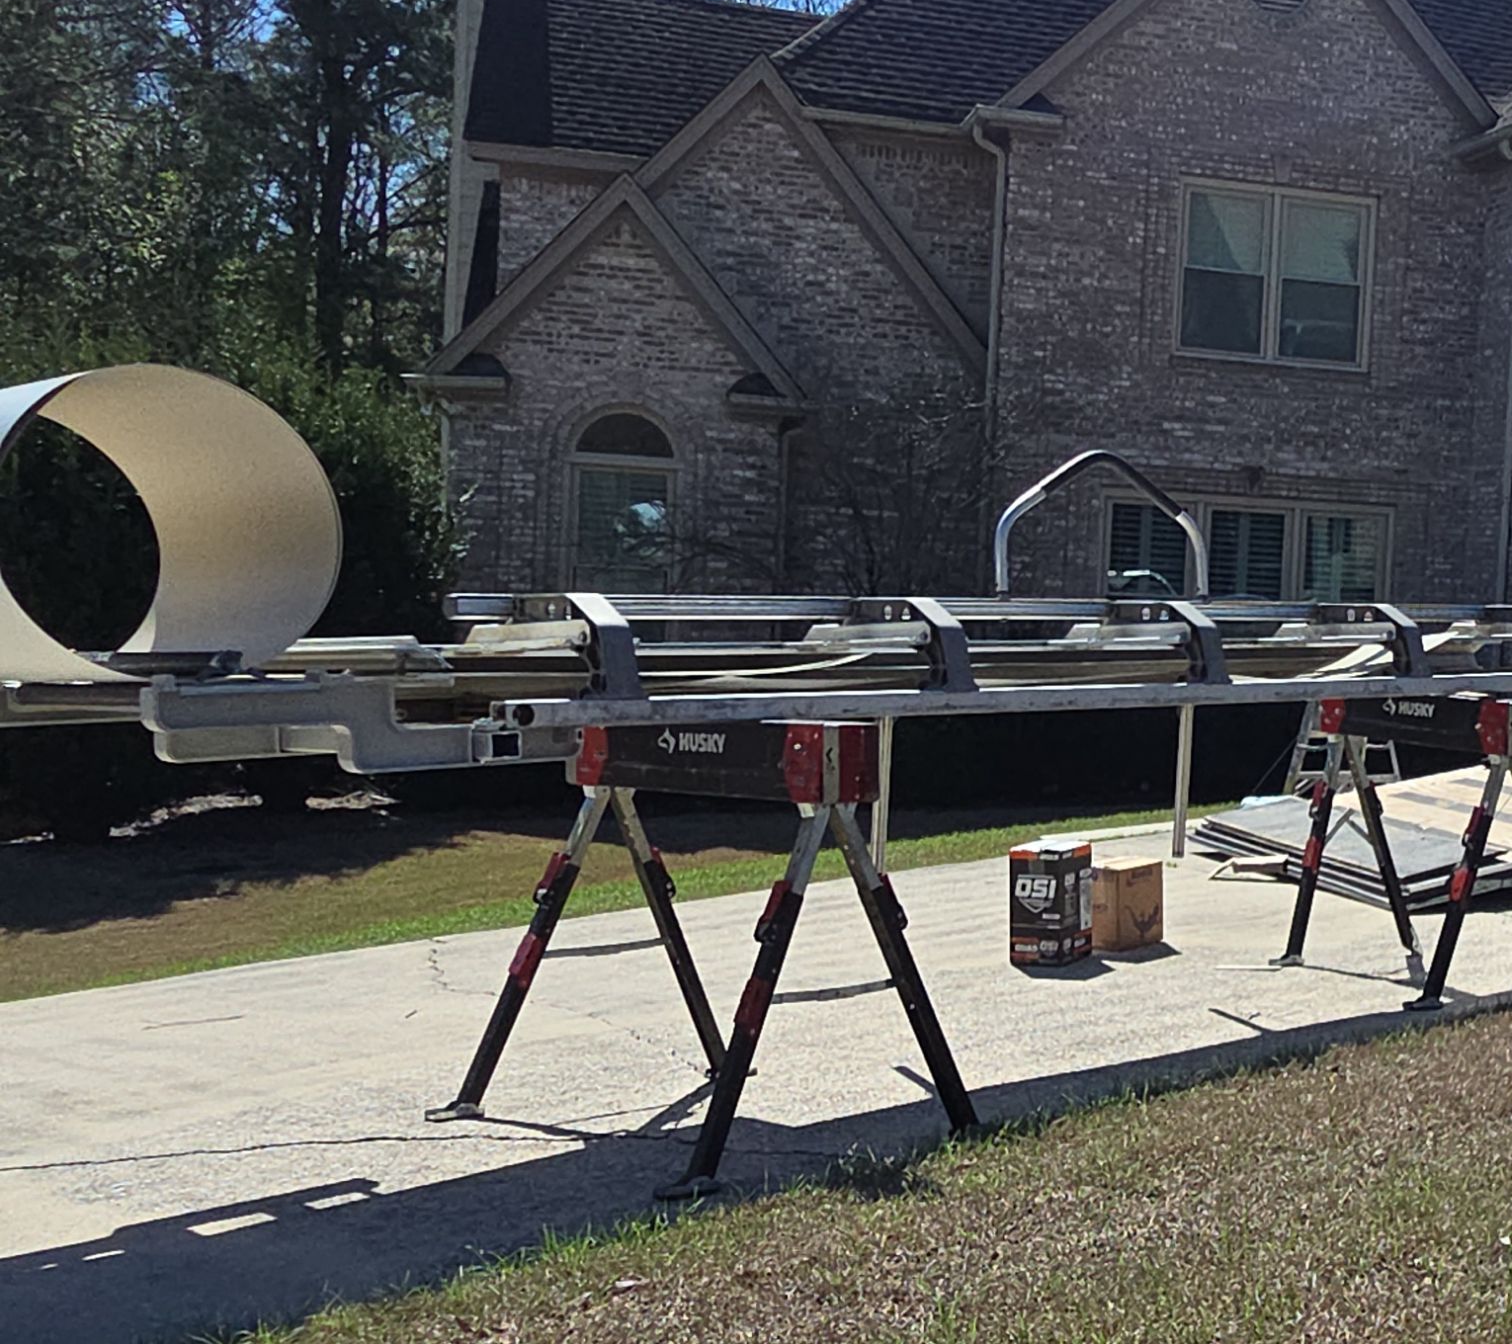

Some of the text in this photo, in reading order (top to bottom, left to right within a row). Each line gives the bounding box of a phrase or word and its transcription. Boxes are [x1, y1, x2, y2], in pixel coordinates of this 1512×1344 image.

[1398, 700, 1435, 719] HUSKY
[678, 732, 726, 754] HUSKY
[1015, 879, 1056, 899] OSI
